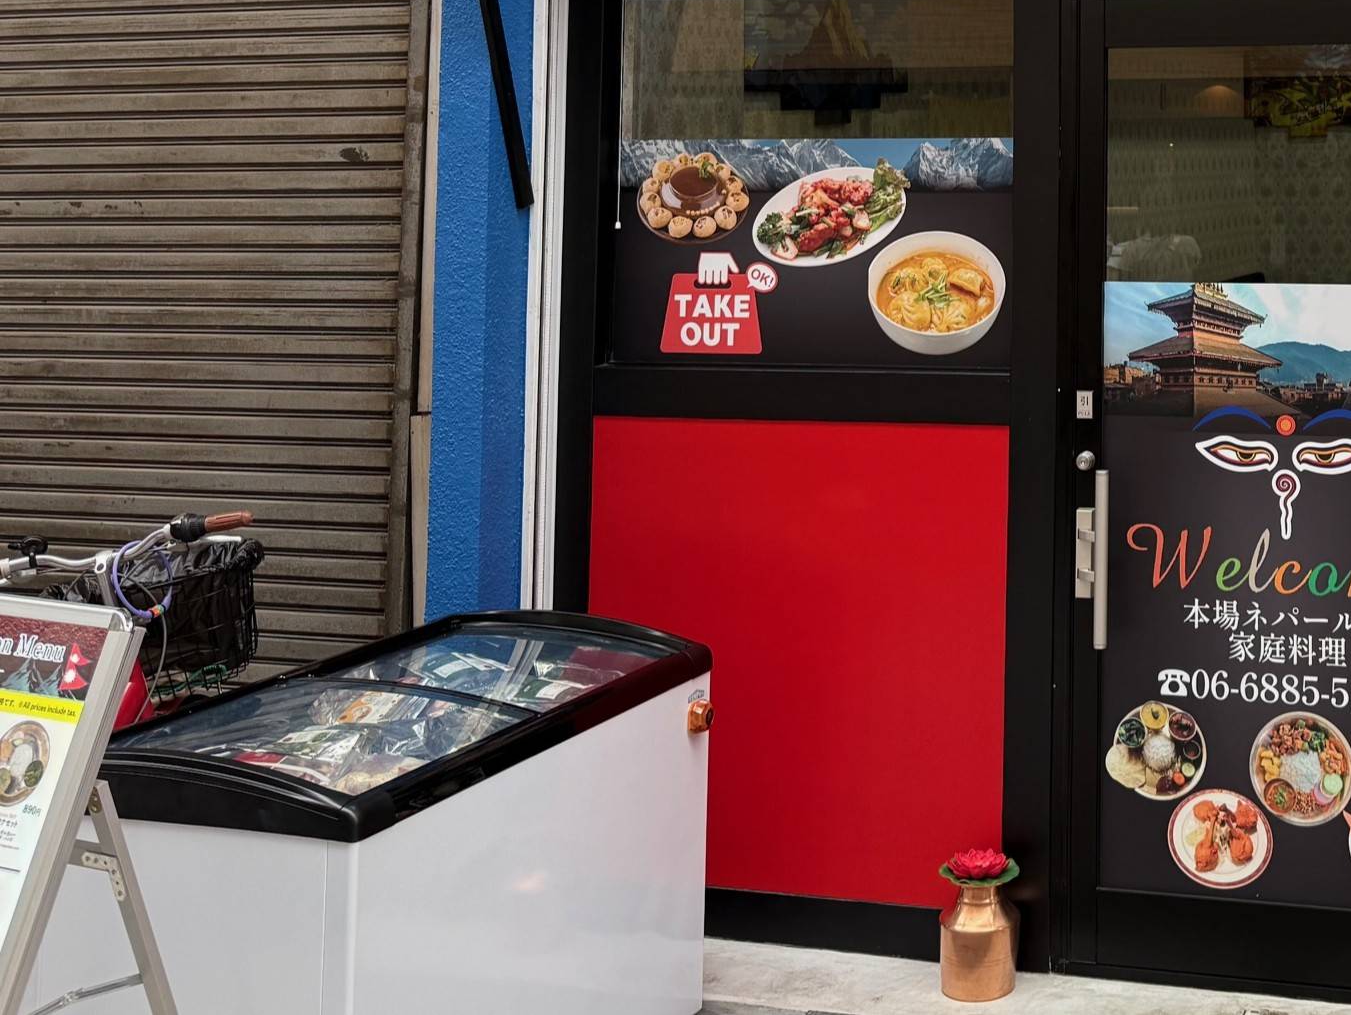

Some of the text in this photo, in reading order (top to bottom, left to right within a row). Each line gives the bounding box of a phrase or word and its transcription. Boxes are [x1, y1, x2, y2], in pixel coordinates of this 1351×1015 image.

[750, 267, 775, 288] OK!
[674, 293, 751, 319] TAKE
[680, 321, 741, 347] OUT
[13, 633, 66, 664] Menu
[1228, 633, 1348, 668] 家庭料理
